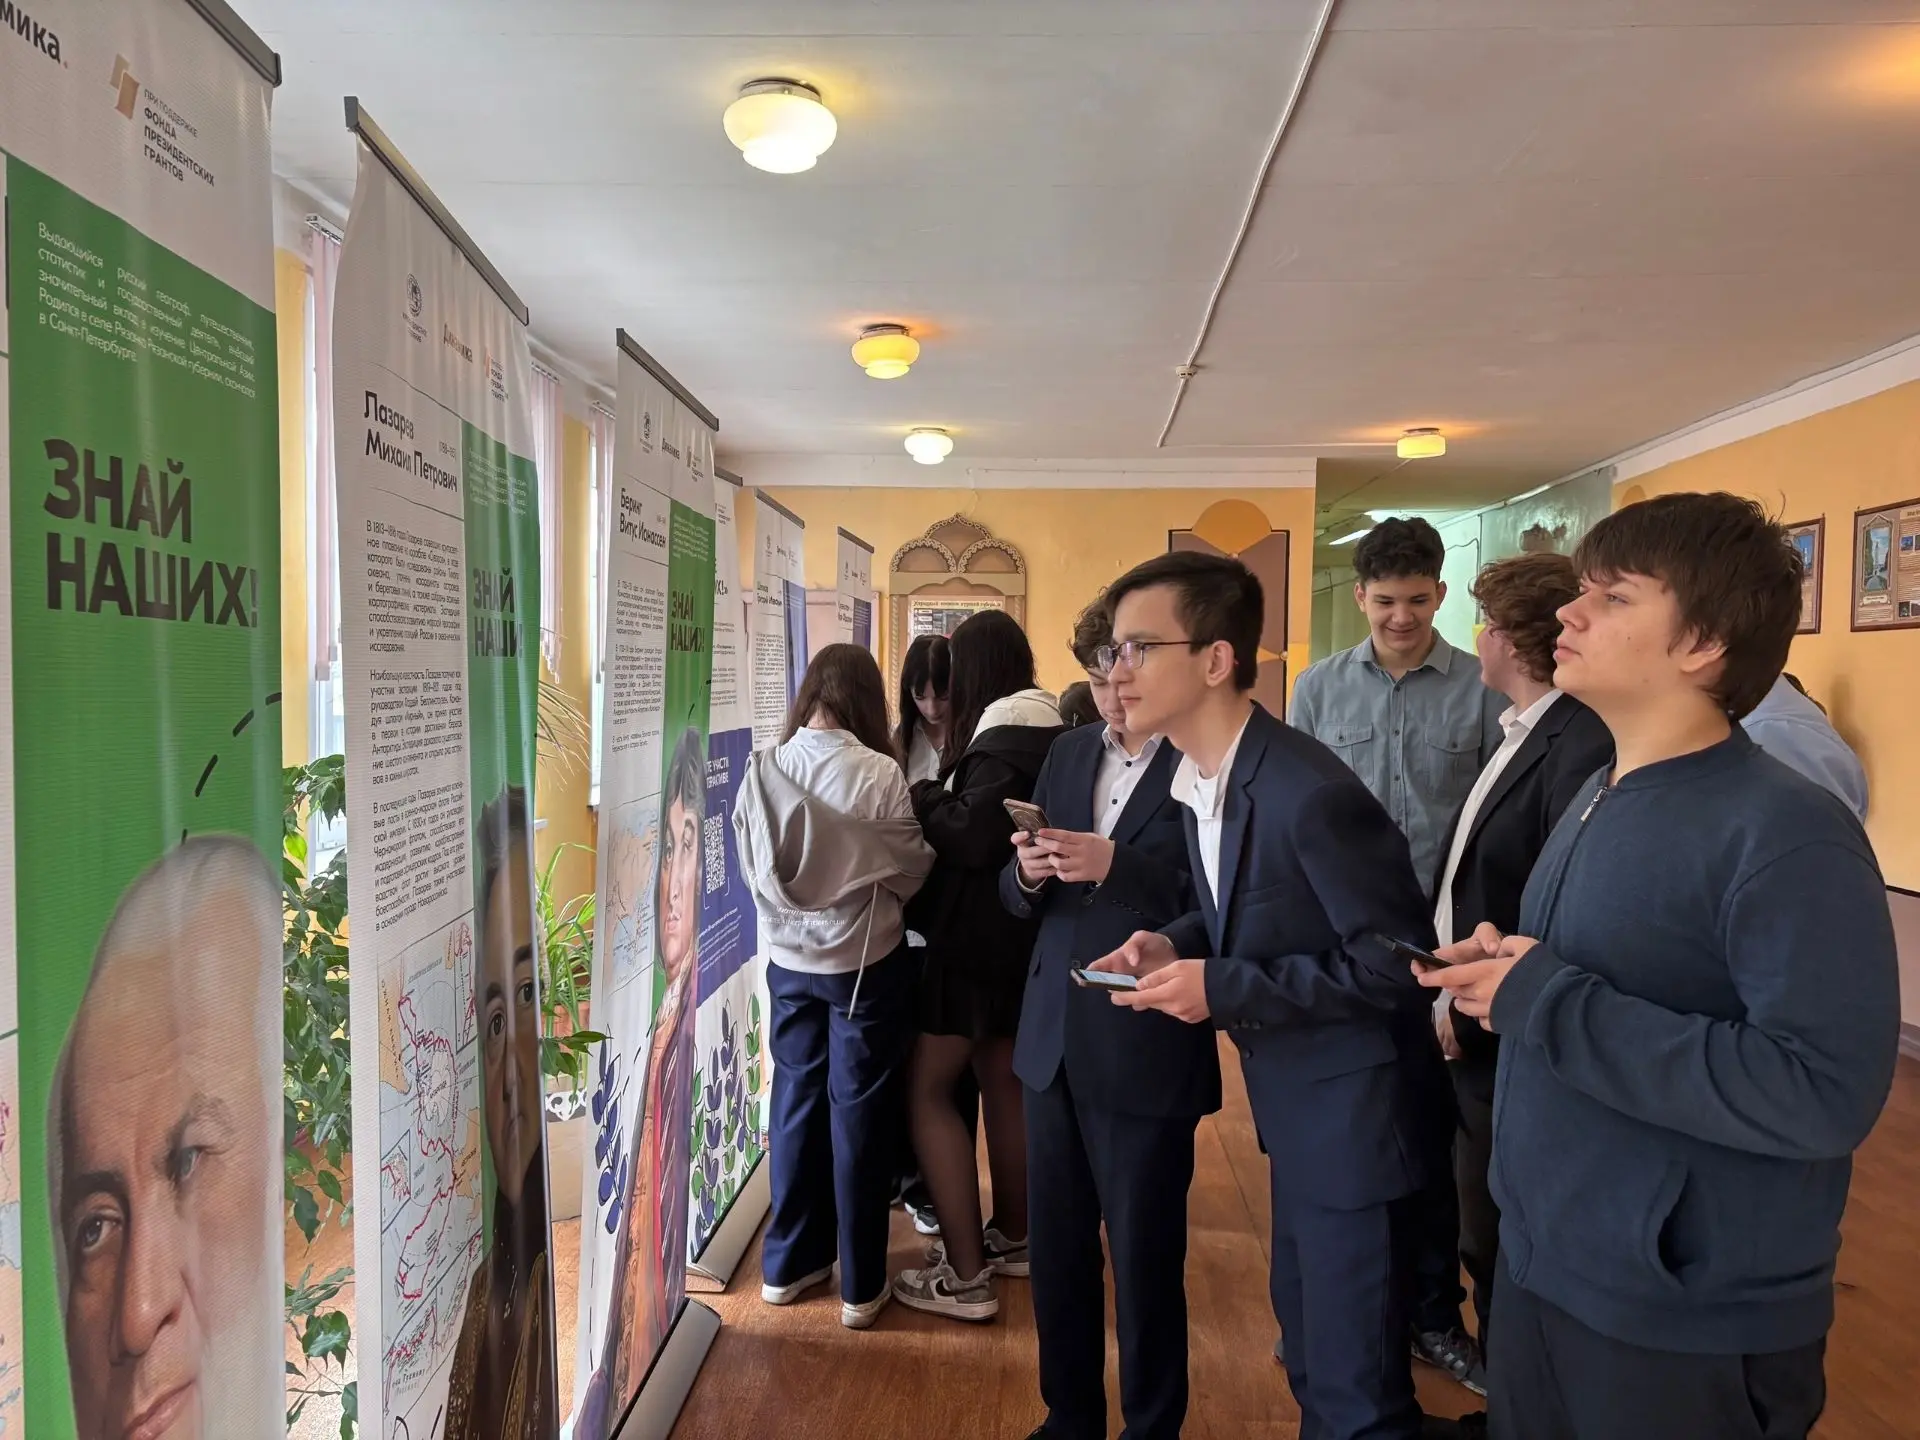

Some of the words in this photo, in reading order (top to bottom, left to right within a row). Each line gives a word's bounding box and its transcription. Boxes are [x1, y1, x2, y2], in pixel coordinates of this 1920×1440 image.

[145, 107, 177, 140] ФОНДА
[144, 144, 184, 182] ГРАНТОВ
[145, 125, 214, 187] ПРЕЗИДЕНТСКИХ
[38, 221, 104, 268] Выдающийся
[38, 248, 86, 281] статистик
[39, 269, 107, 310] значительный
[39, 286, 80, 318] Родился
[89, 314, 113, 333] селе
[40, 313, 47, 325] в
[363, 390, 414, 440] Лазарев
[366, 428, 412, 473] Михаил
[414, 449, 458, 492] Петрович
[43, 438, 193, 544] ЗНАЙ
[366, 519, 372, 532] В
[46, 531, 258, 628] НАШИХ!
[473, 567, 515, 613] ЗНАЙ
